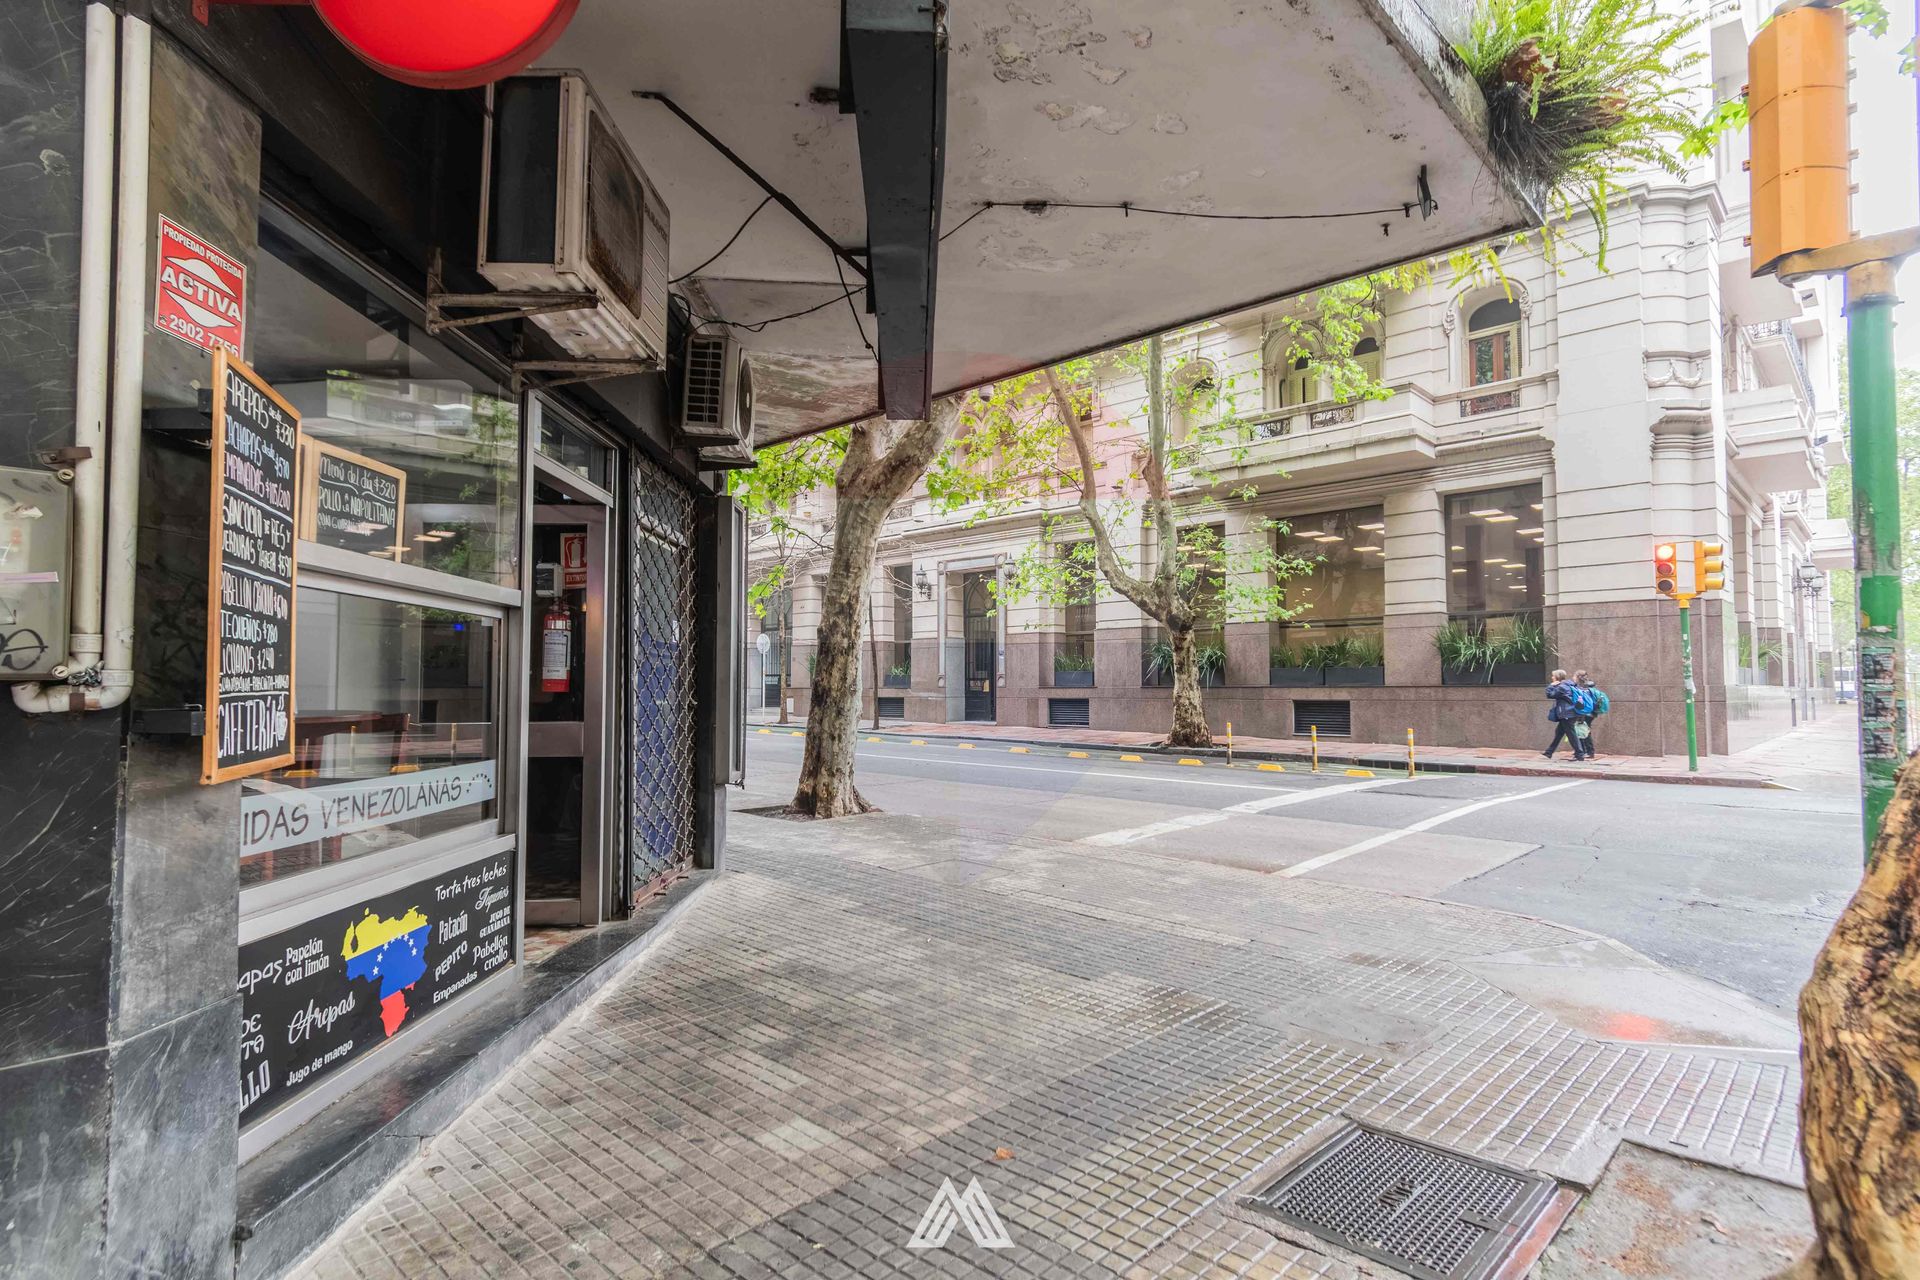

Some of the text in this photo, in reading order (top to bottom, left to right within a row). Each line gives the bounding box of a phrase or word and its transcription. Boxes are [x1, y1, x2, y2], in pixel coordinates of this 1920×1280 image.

[163, 224, 242, 279] PROPIEDAD PROTEGIDA
[161, 265, 242, 322] ACTIVA
[169, 314, 205, 343] 2902
[226, 369, 269, 429] AREPAS
[320, 457, 344, 481] Menú
[347, 466, 359, 486] del
[373, 476, 396, 500] $320
[223, 493, 262, 538] SANCOCHO
[318, 486, 341, 511] POLLO
[220, 609, 261, 643] TEQUEÑOS
[321, 776, 463, 830] VENEZOLANAS
[435, 861, 507, 902] Torta tres leches
[439, 910, 468, 944] Patacón
[286, 937, 323, 966] Papelón
[434, 940, 468, 982] PEPITO
[473, 934, 508, 965] Pabellón
[484, 947, 508, 971] criollo
[237, 959, 283, 995] apas
[285, 954, 330, 986] con limón
[433, 970, 478, 1004] Empanadas
[288, 991, 356, 1045] Arepas
[286, 1039, 353, 1087] Jugo de mango
